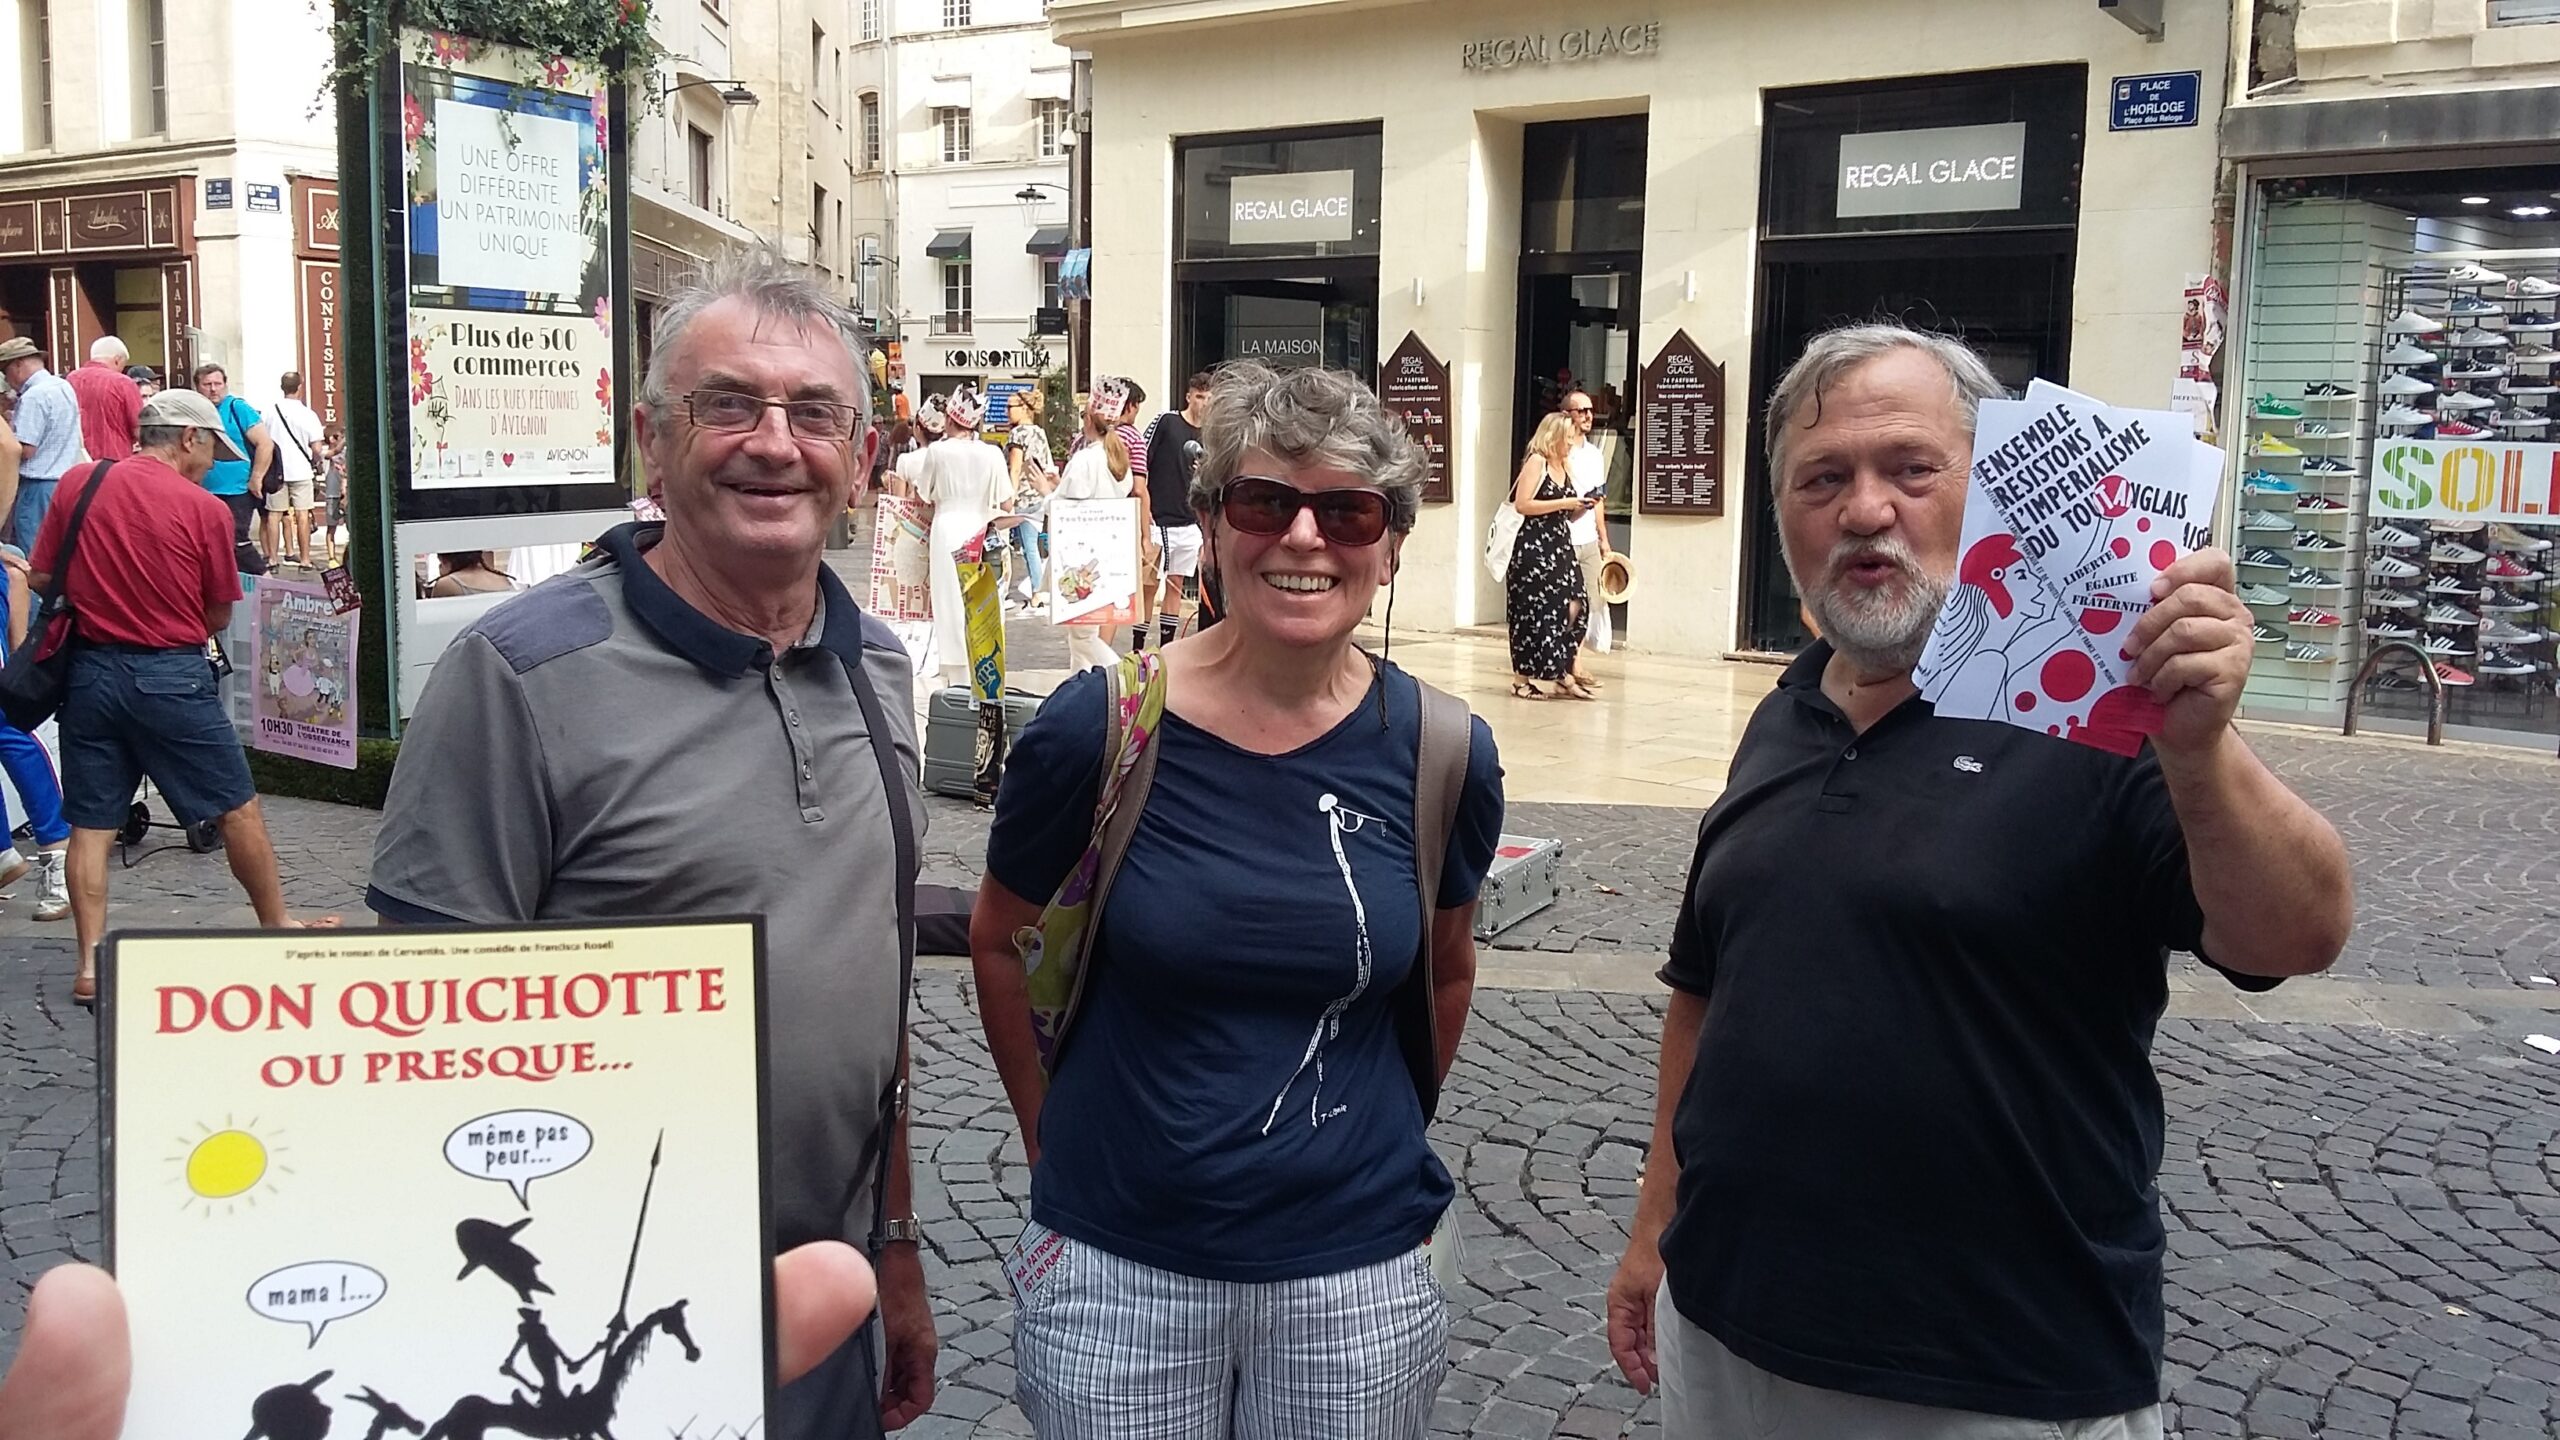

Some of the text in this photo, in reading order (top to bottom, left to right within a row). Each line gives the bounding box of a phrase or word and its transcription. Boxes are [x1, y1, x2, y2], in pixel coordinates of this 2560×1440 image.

[1463, 21, 1661, 69] REGAL GLACE
[2139, 80, 2171, 91] PLACE
[2149, 93, 2160, 101] DE
[2124, 101, 2186, 116] L'HORLOGE
[460, 144, 559, 178] UNE OFFRE
[1845, 156, 2016, 188] REGAL GLACE
[440, 200, 579, 234] UN PATRIMOINE
[1235, 197, 1348, 220] REGAL GLACE
[478, 231, 549, 260] UNIQUE
[320, 271, 336, 423] CONFISERIE
[450, 322, 577, 351] Plus de 500
[1241, 339, 1322, 354] LA MAISON
[453, 355, 580, 379] commerces
[945, 350, 1050, 368] KONSORTIUM
[1401, 356, 1423, 365] REGAL
[1401, 366, 1424, 375] GLACE
[1667, 355, 1693, 364] REGAL
[1667, 365, 1694, 375] GLACE
[546, 448, 589, 462] AVIGNON
[1975, 403, 2077, 485] ENSEMBLE
[1993, 414, 2112, 510] RESISTONS A
[2009, 420, 2151, 535] L'IMPERIALISME
[2026, 524, 2060, 560] DU
[2113, 480, 2188, 520] ANGLAIS
[282, 591, 333, 616] Ambre
[261, 717, 293, 736] 10H30
[331, 730, 342, 738] DE
[297, 731, 350, 747] L'OBSERVANCE
[155, 967, 727, 1037] DON QUICHOTTE
[260, 1041, 634, 1089] OU PRESQUE...
[468, 1123, 569, 1149] même pas
[485, 1149, 552, 1173] peur...
[1015, 1265, 1028, 1282] MA
[1024, 1275, 1036, 1292] EST
[1034, 1264, 1047, 1280] UN
[268, 1286, 329, 1306] mama
